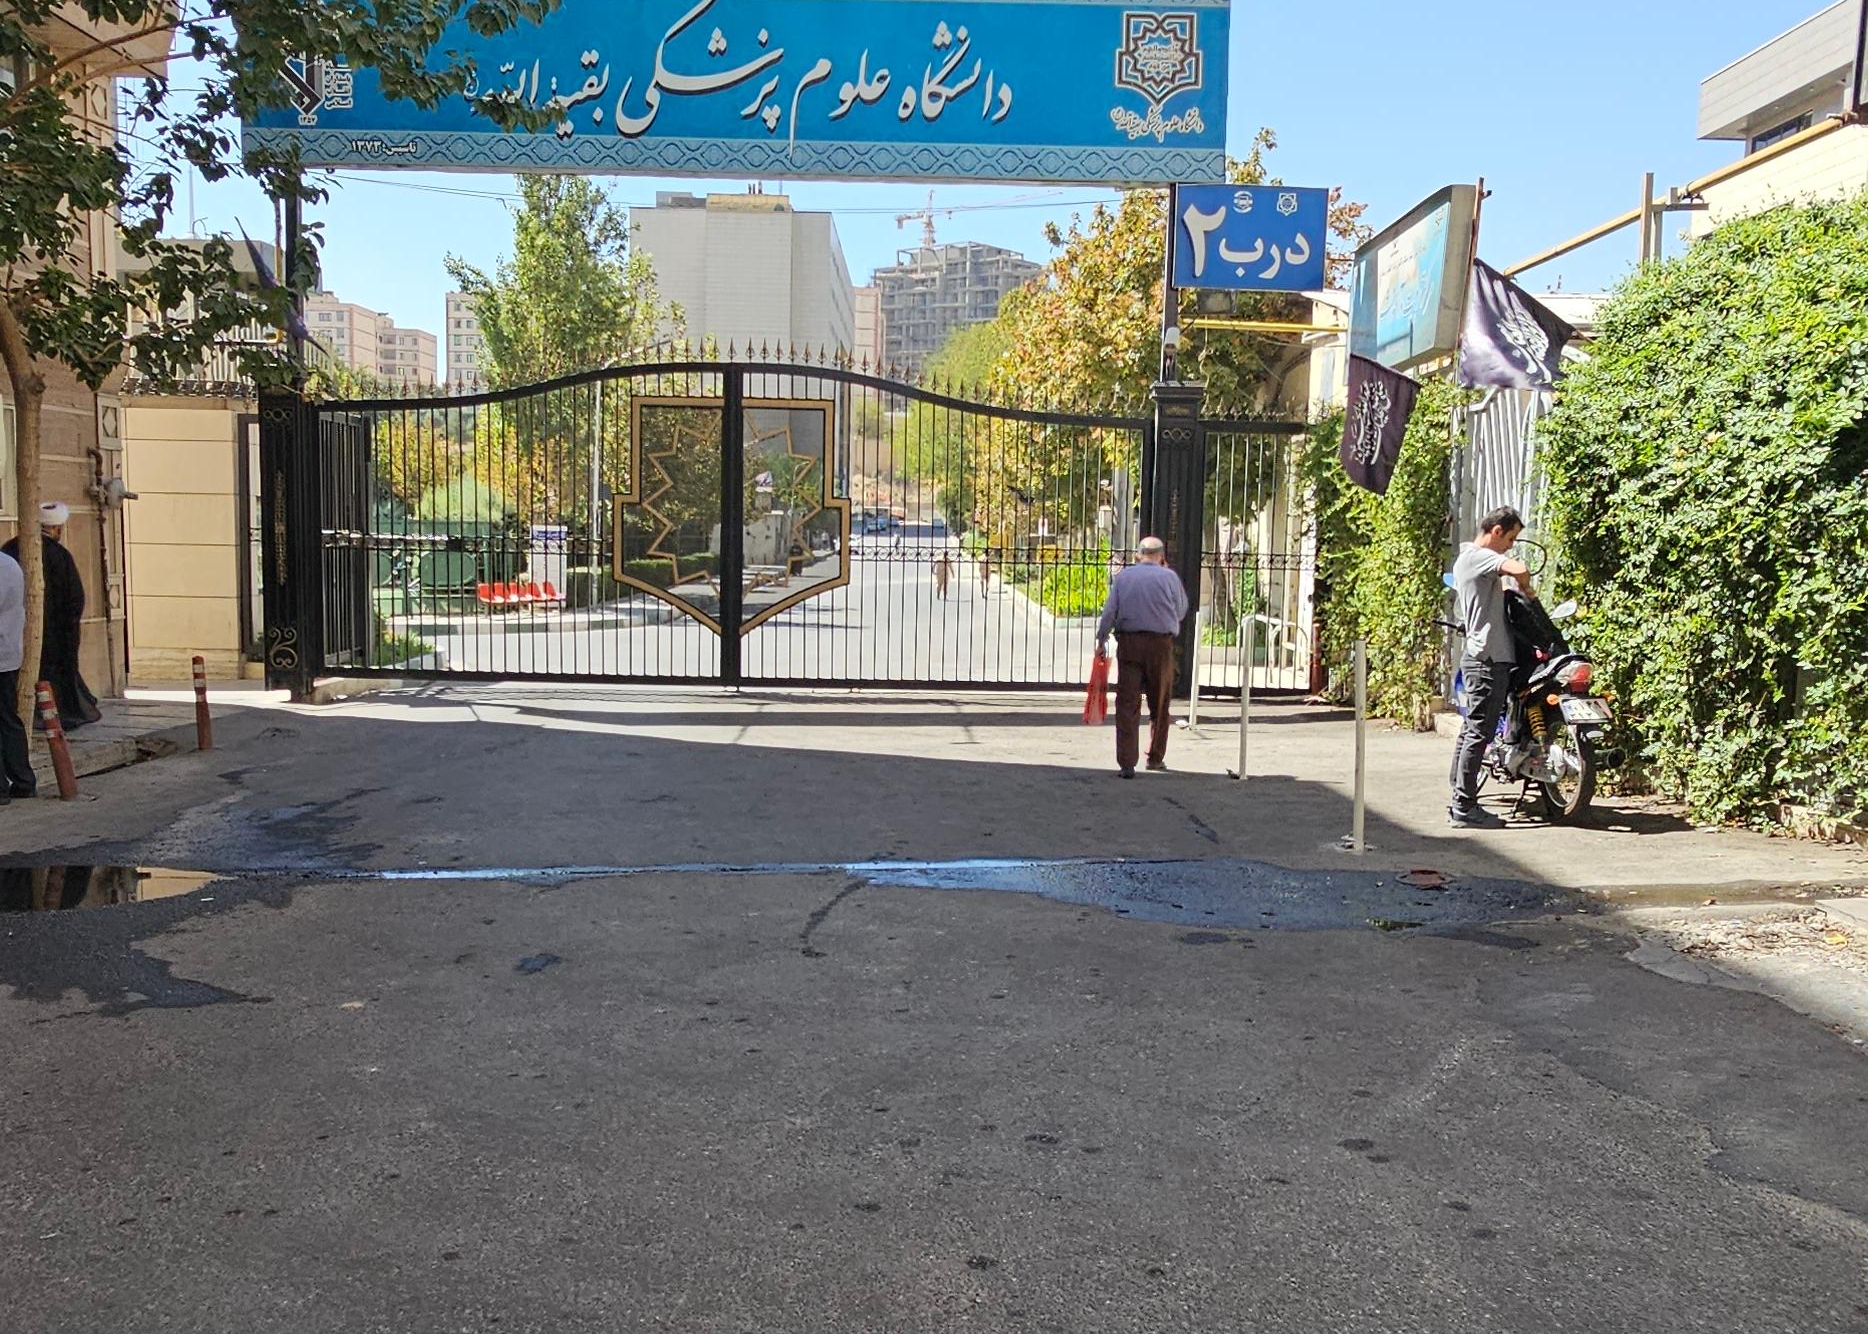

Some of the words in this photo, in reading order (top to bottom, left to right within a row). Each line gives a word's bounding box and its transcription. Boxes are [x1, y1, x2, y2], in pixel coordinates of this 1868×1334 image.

[788, 48, 892, 159] علوم
[898, 20, 1012, 123] دانشگاه
[1182, 203, 1227, 279] ۲
[1218, 232, 1311, 279] درب
